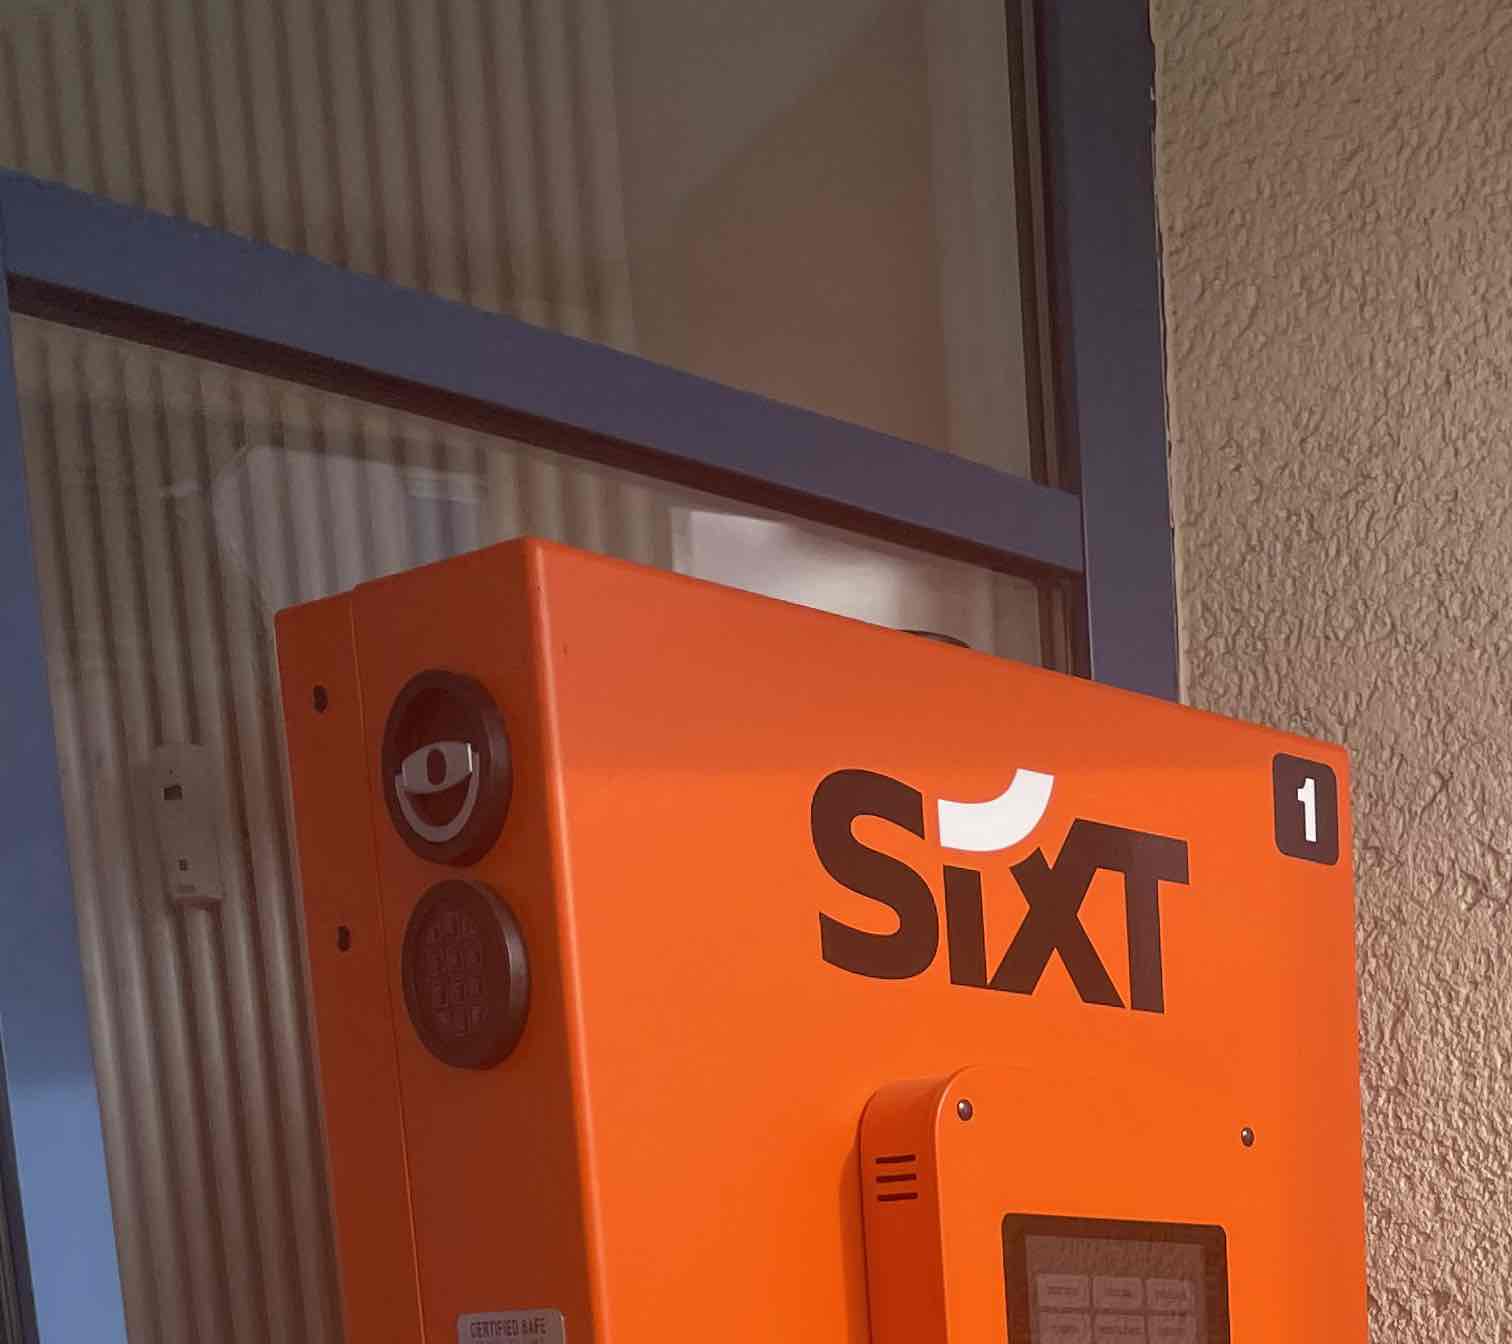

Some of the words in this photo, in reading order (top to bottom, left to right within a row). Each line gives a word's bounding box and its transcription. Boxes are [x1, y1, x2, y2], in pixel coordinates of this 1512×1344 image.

[1297, 777, 1317, 843] 1
[470, 1319, 520, 1339] CERTIFIED
[522, 1317, 547, 1335] SAFE
